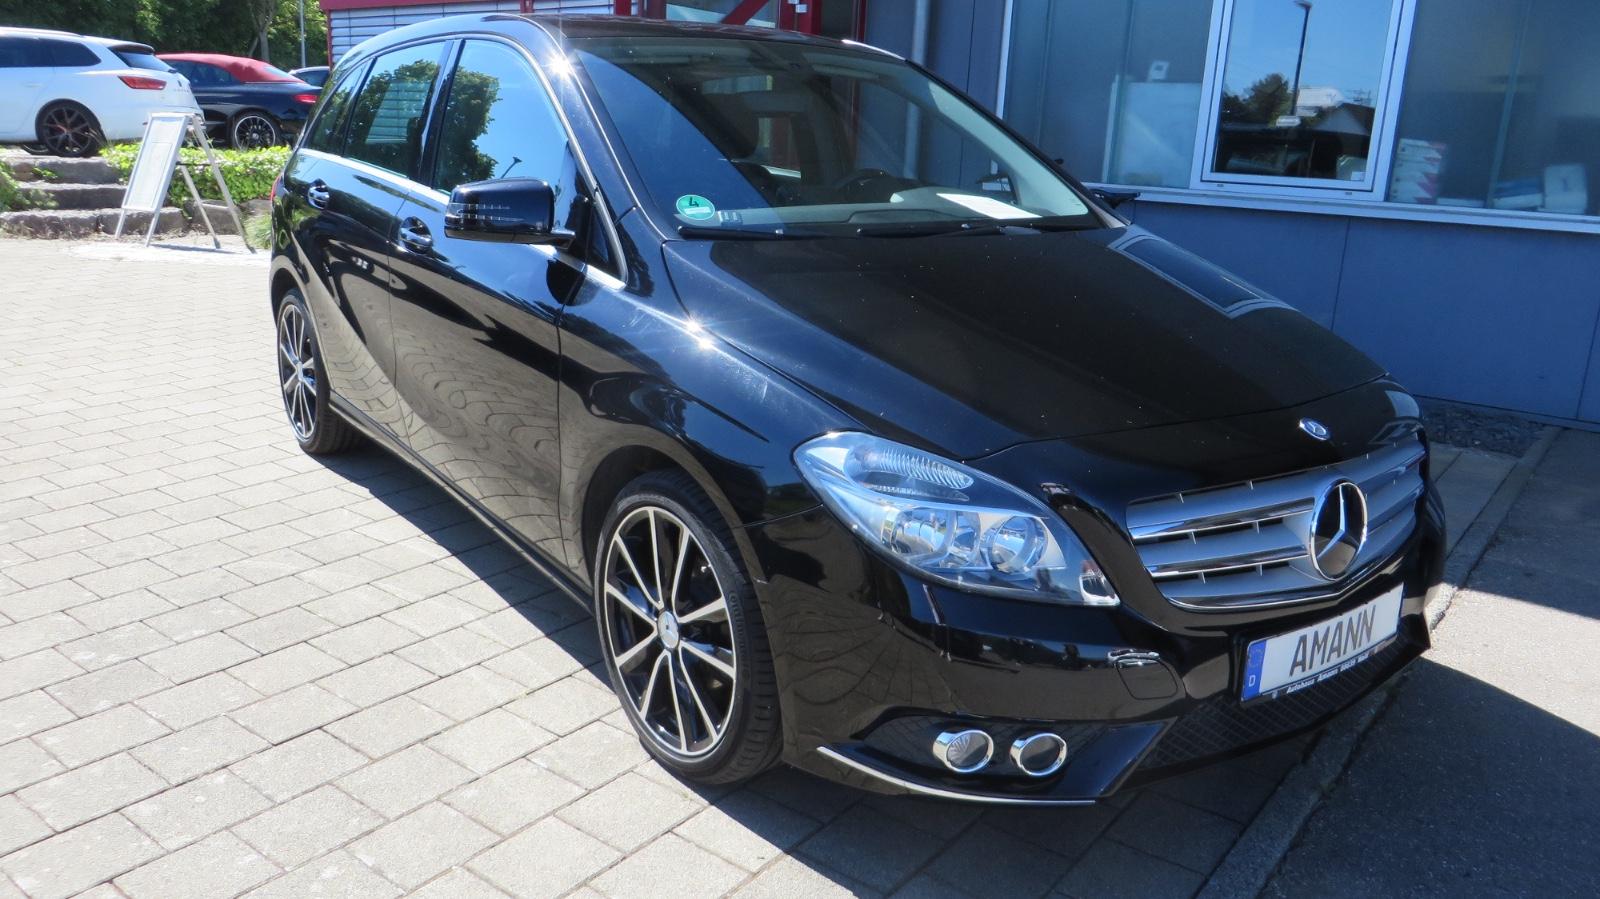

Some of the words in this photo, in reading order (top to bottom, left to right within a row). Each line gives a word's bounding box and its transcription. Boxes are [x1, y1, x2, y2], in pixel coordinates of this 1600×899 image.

[689, 197, 699, 207] 4
[1289, 605, 1376, 678] AMANN
[1248, 674, 1256, 688] D
